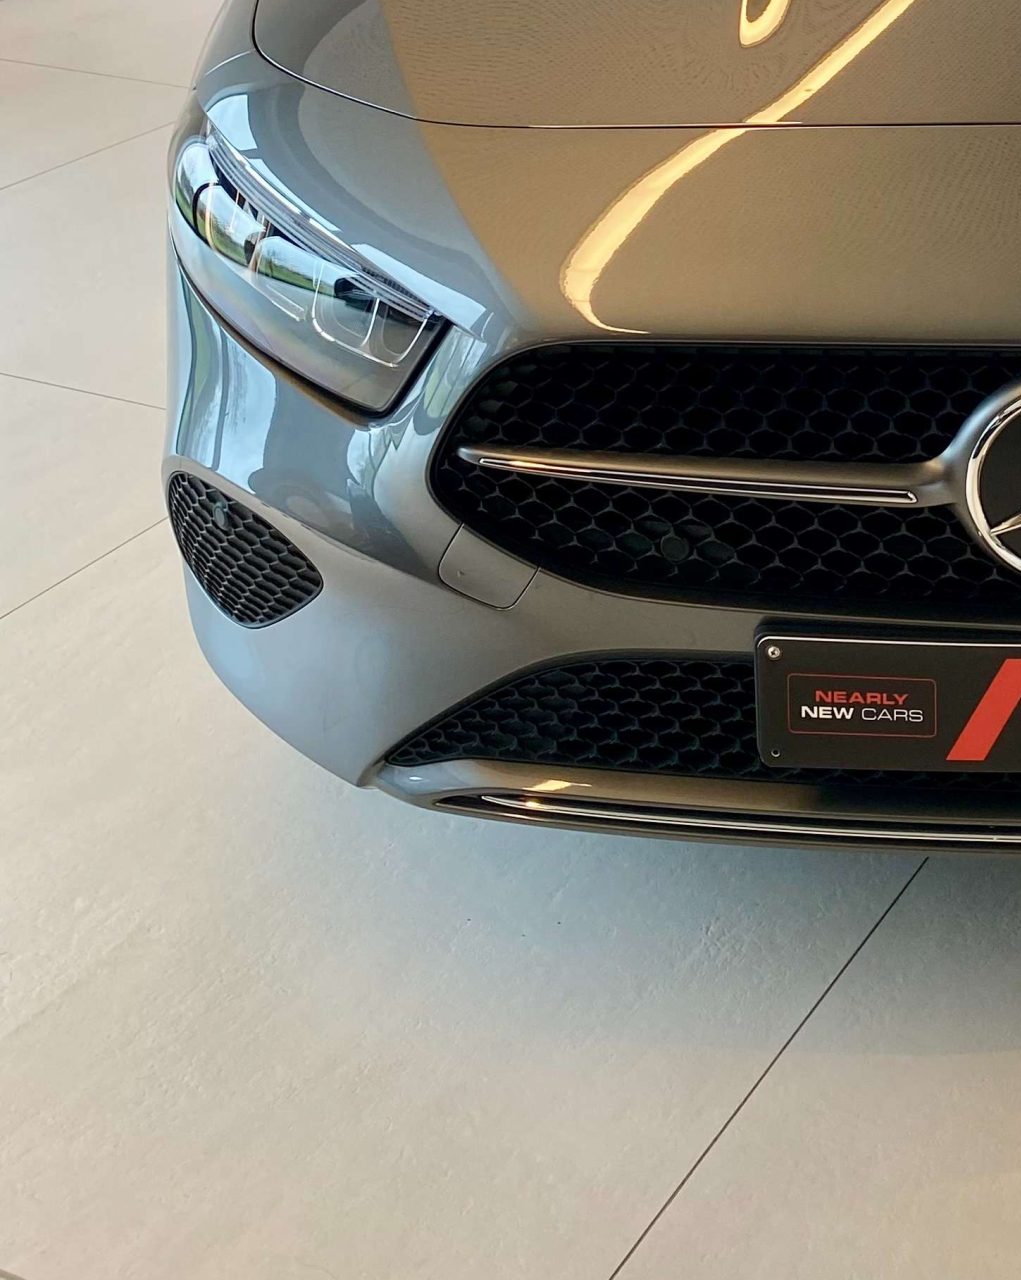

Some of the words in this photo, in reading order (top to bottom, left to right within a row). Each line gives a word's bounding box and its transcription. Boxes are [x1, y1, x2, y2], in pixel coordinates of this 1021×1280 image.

[815, 690, 909, 705] NEARLY
[801, 705, 854, 720] NEW
[861, 707, 924, 723] CARS
